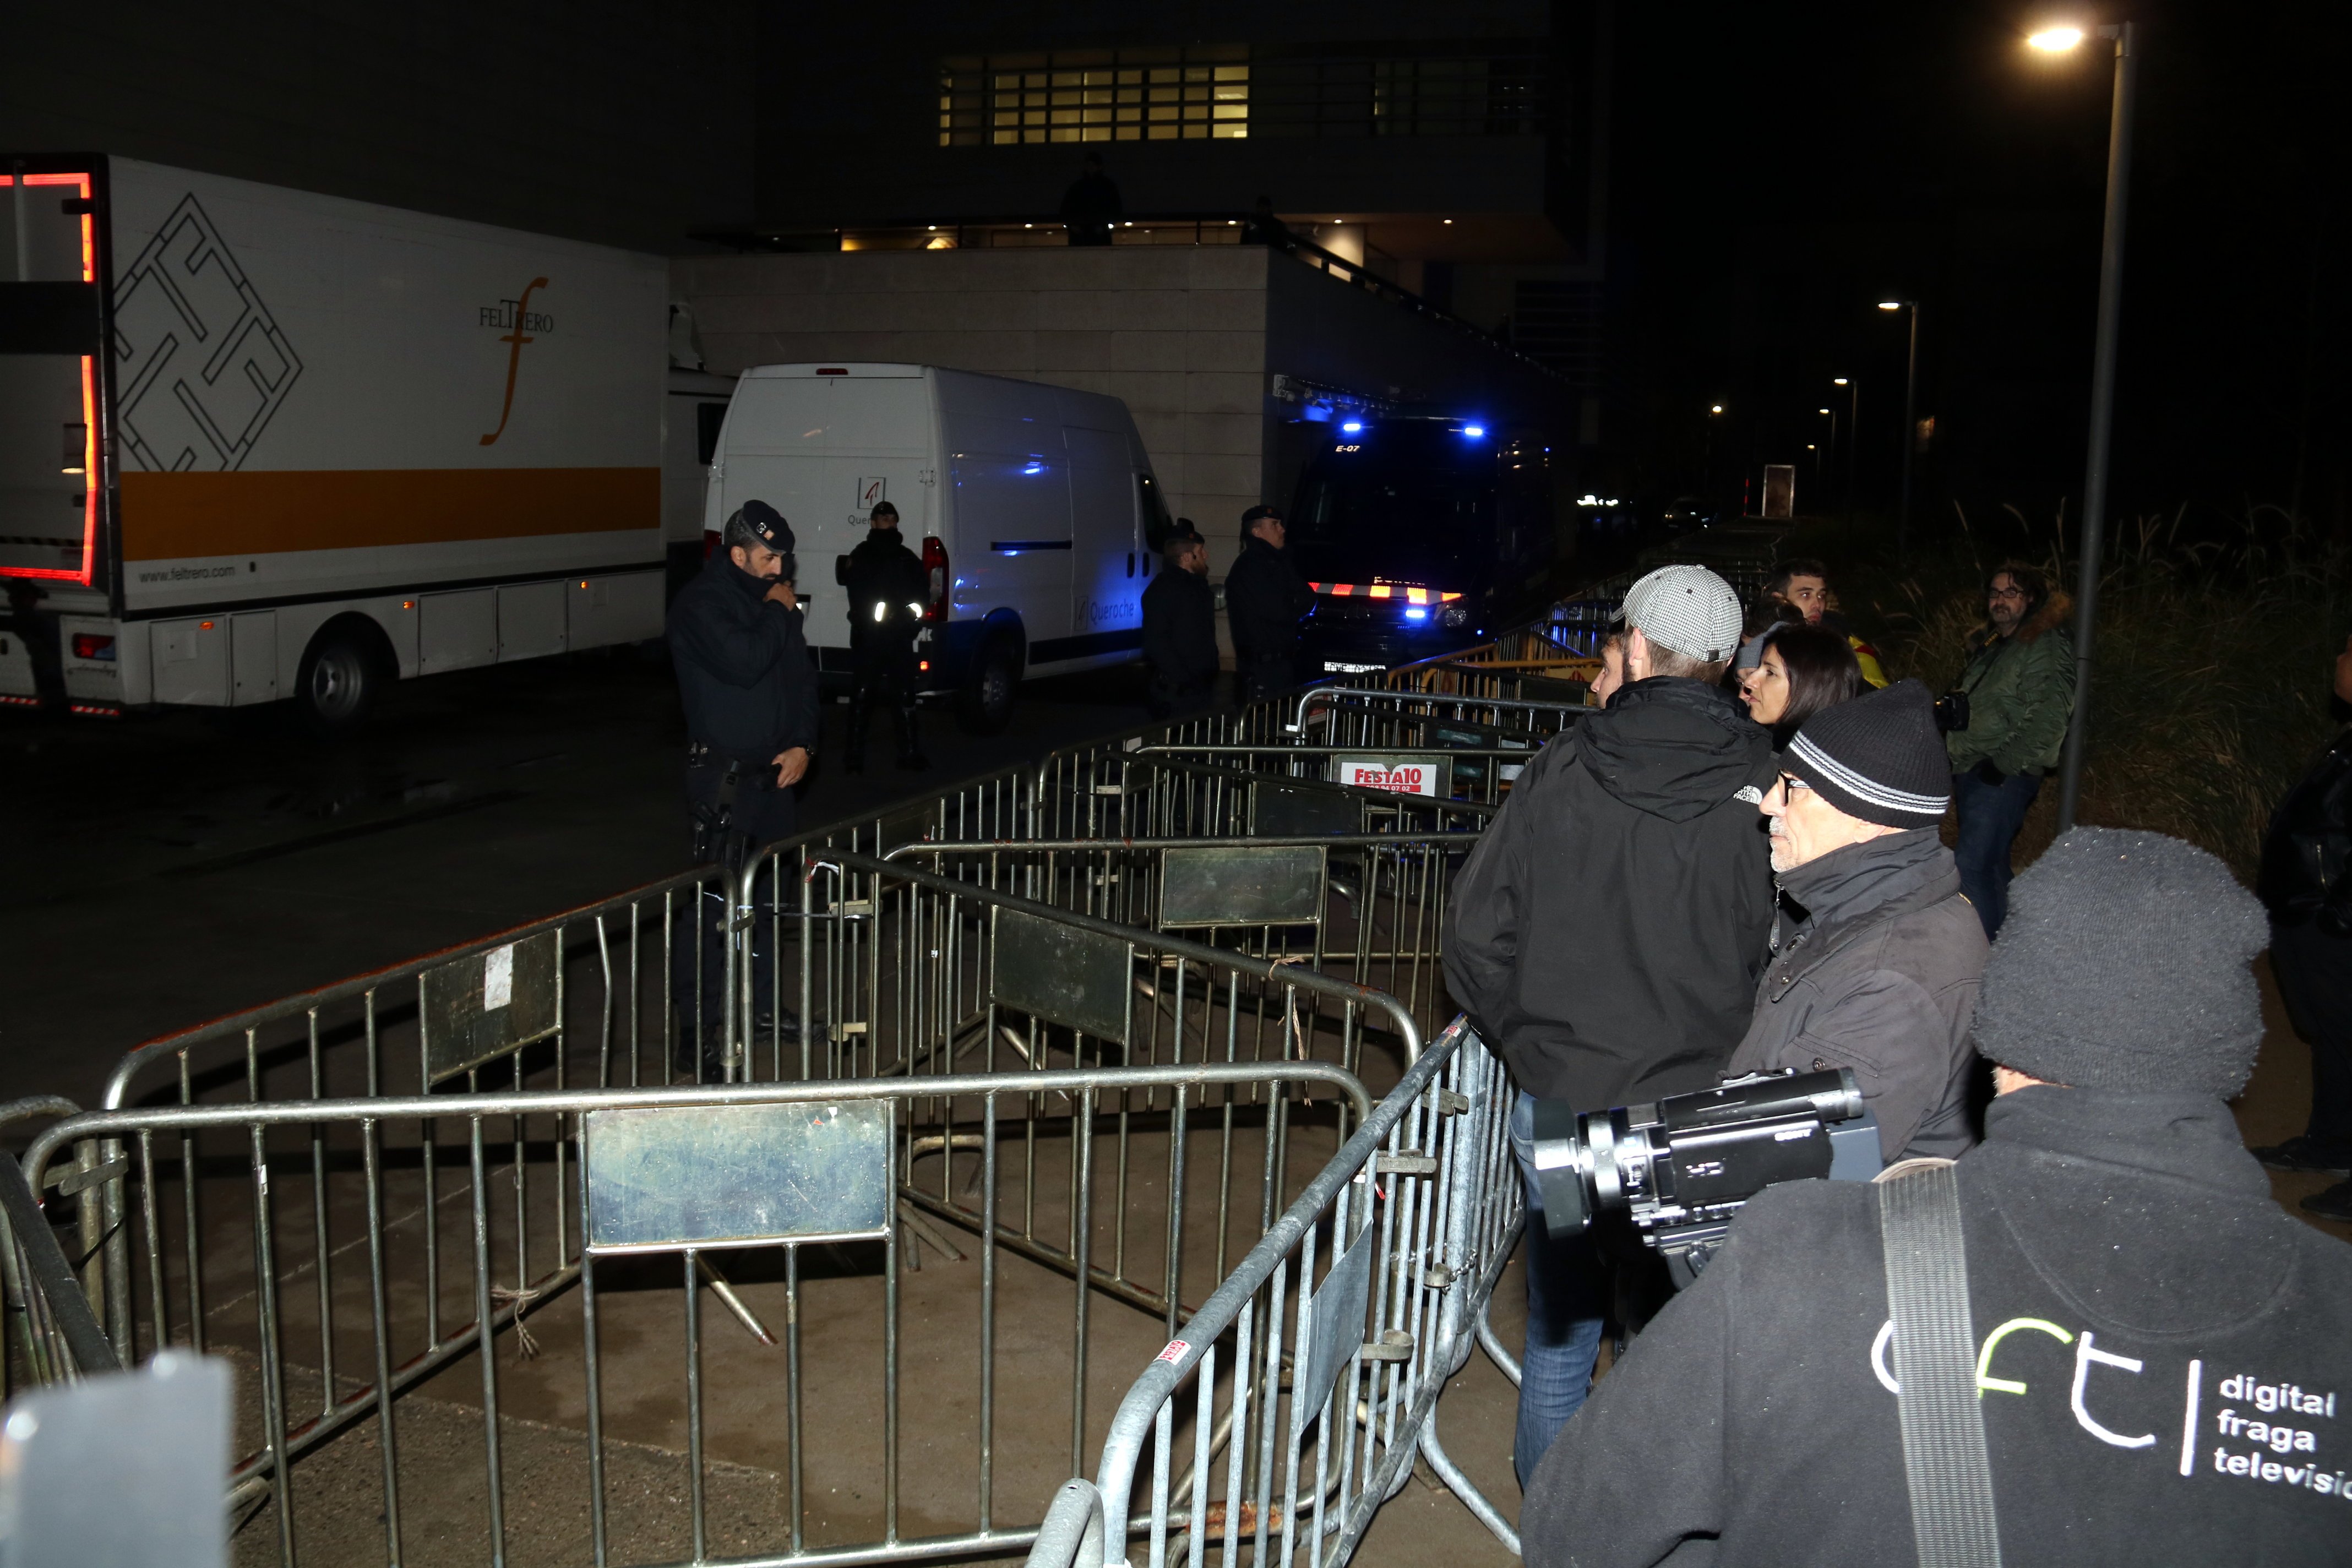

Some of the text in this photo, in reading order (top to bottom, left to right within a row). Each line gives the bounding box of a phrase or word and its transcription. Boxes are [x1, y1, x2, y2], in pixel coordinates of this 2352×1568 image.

[480, 299, 553, 333] FELTRERO
[848, 515, 871, 526] Quer
[139, 567, 236, 582] www.feltrero.com
[1090, 598, 1134, 625] Queroche
[1354, 768, 1422, 784] FESTA10
[1733, 793, 1751, 802] FACE
[2220, 1374, 2336, 1418] digital
[2217, 1409, 2316, 1453] fraga
